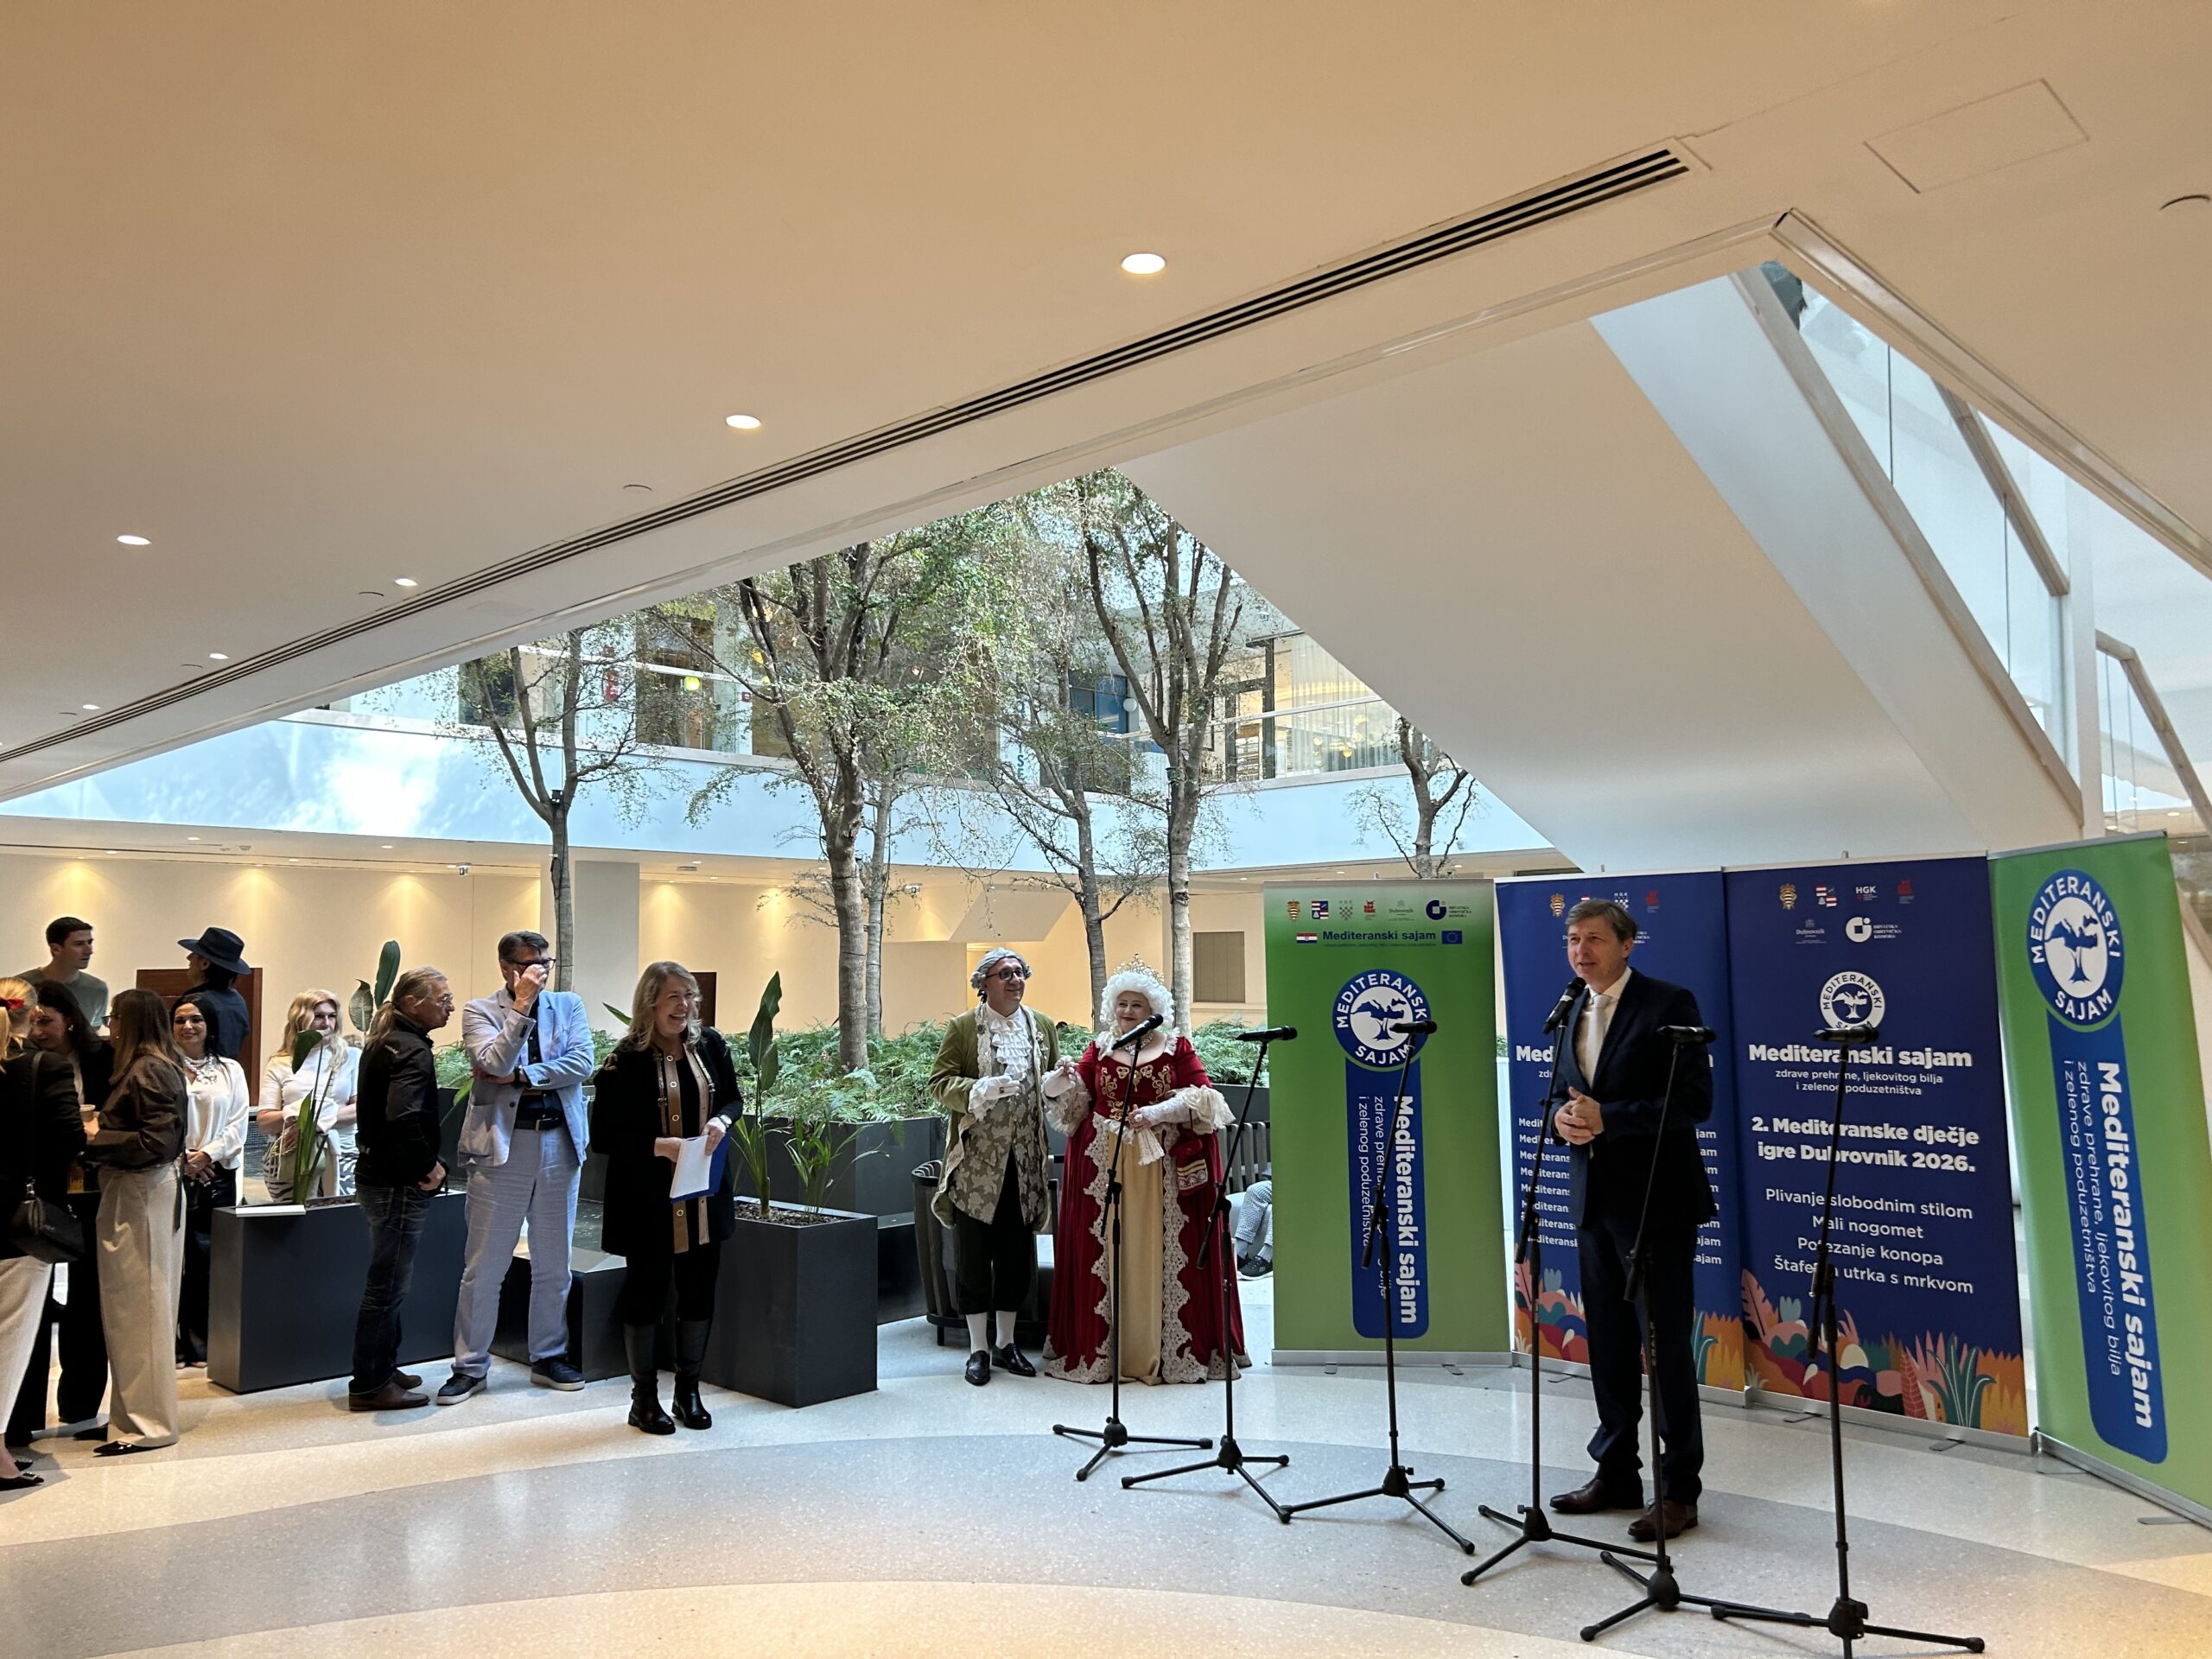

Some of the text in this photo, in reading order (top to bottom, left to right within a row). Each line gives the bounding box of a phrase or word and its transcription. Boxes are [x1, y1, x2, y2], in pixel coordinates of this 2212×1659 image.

[2031, 876, 2120, 963] MEDITERANSKI
[1323, 931, 1436, 942] Mediteranski sajam
[1336, 973, 1427, 1028] MEDITERANSK
[1823, 975, 1882, 1010] MEDITERANSKI
[2055, 988, 2113, 1020] SAJAM
[1749, 1045, 1973, 1069] Mediteranski sajam
[1776, 1070, 1943, 1084] zdrave prehrne, ljekovitog bilja
[1796, 1082, 1800, 1090] i
[1845, 1084, 1922, 1096] poduzetništva
[1375, 1096, 1386, 1138] zdrave
[2064, 1071, 2081, 1147] zelenog
[1358, 1103, 1370, 1153] zelenog
[1751, 1116, 1769, 1132] 2.
[1913, 1125, 1980, 1147] dječje
[1758, 1141, 1976, 1173] igre Dubrovnik 2026.
[1394, 1096, 1421, 1324] Mediteranski sajam
[1765, 1188, 1973, 1219] Plivanje slobodnim stilom
[2078, 1061, 2121, 1376] zdrave prehrane, ljekovitog bilja
[1812, 1215, 1924, 1239] Mali nogomet
[2072, 1153, 2096, 1293] poduzetništva
[1694, 1253, 1722, 1265] ajam
[1880, 1245, 1943, 1266] konopa
[2097, 1062, 2152, 1428] Mediteranski sajam
[1843, 1268, 1885, 1282] utrka
[1890, 1274, 1899, 1284] s
[1904, 1274, 1974, 1294] mrkvom
